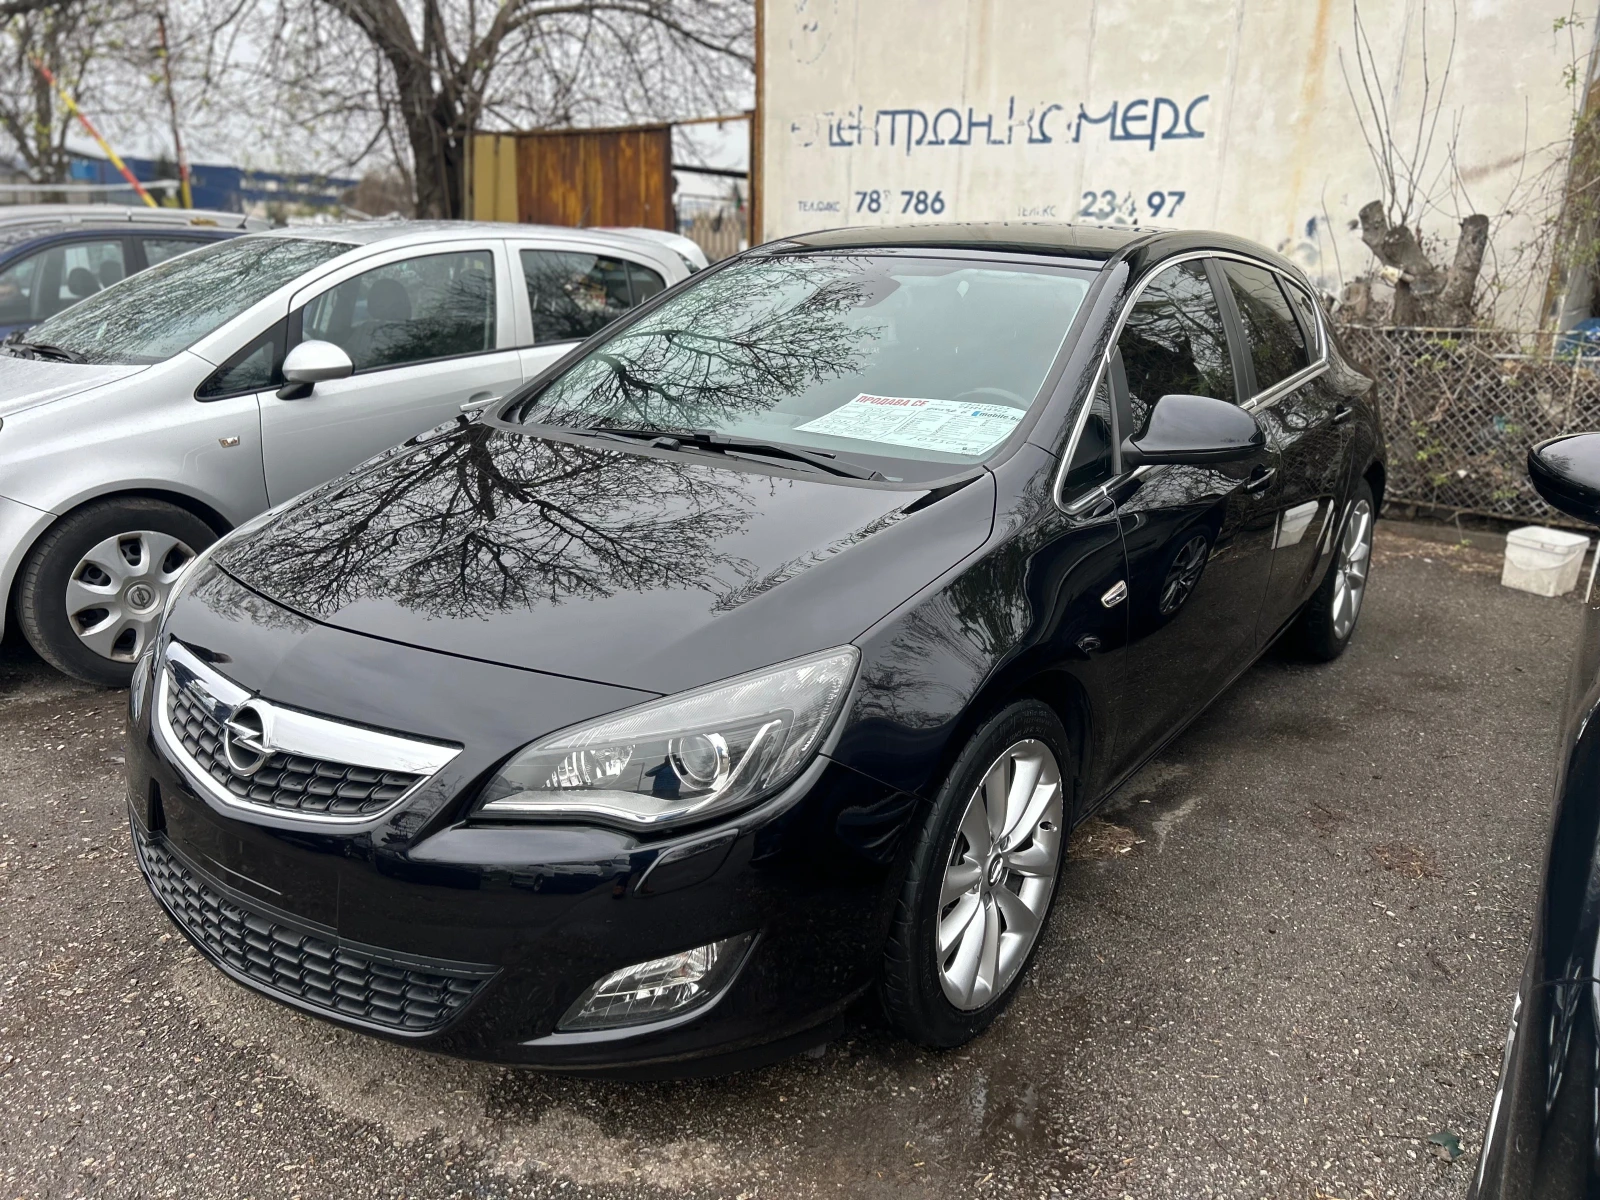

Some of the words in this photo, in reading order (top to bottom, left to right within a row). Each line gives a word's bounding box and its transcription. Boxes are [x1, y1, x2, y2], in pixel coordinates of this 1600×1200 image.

[900, 190, 945, 215] 786
[1147, 191, 1186, 218] 97
[855, 395, 911, 407] ПРОДАВА
